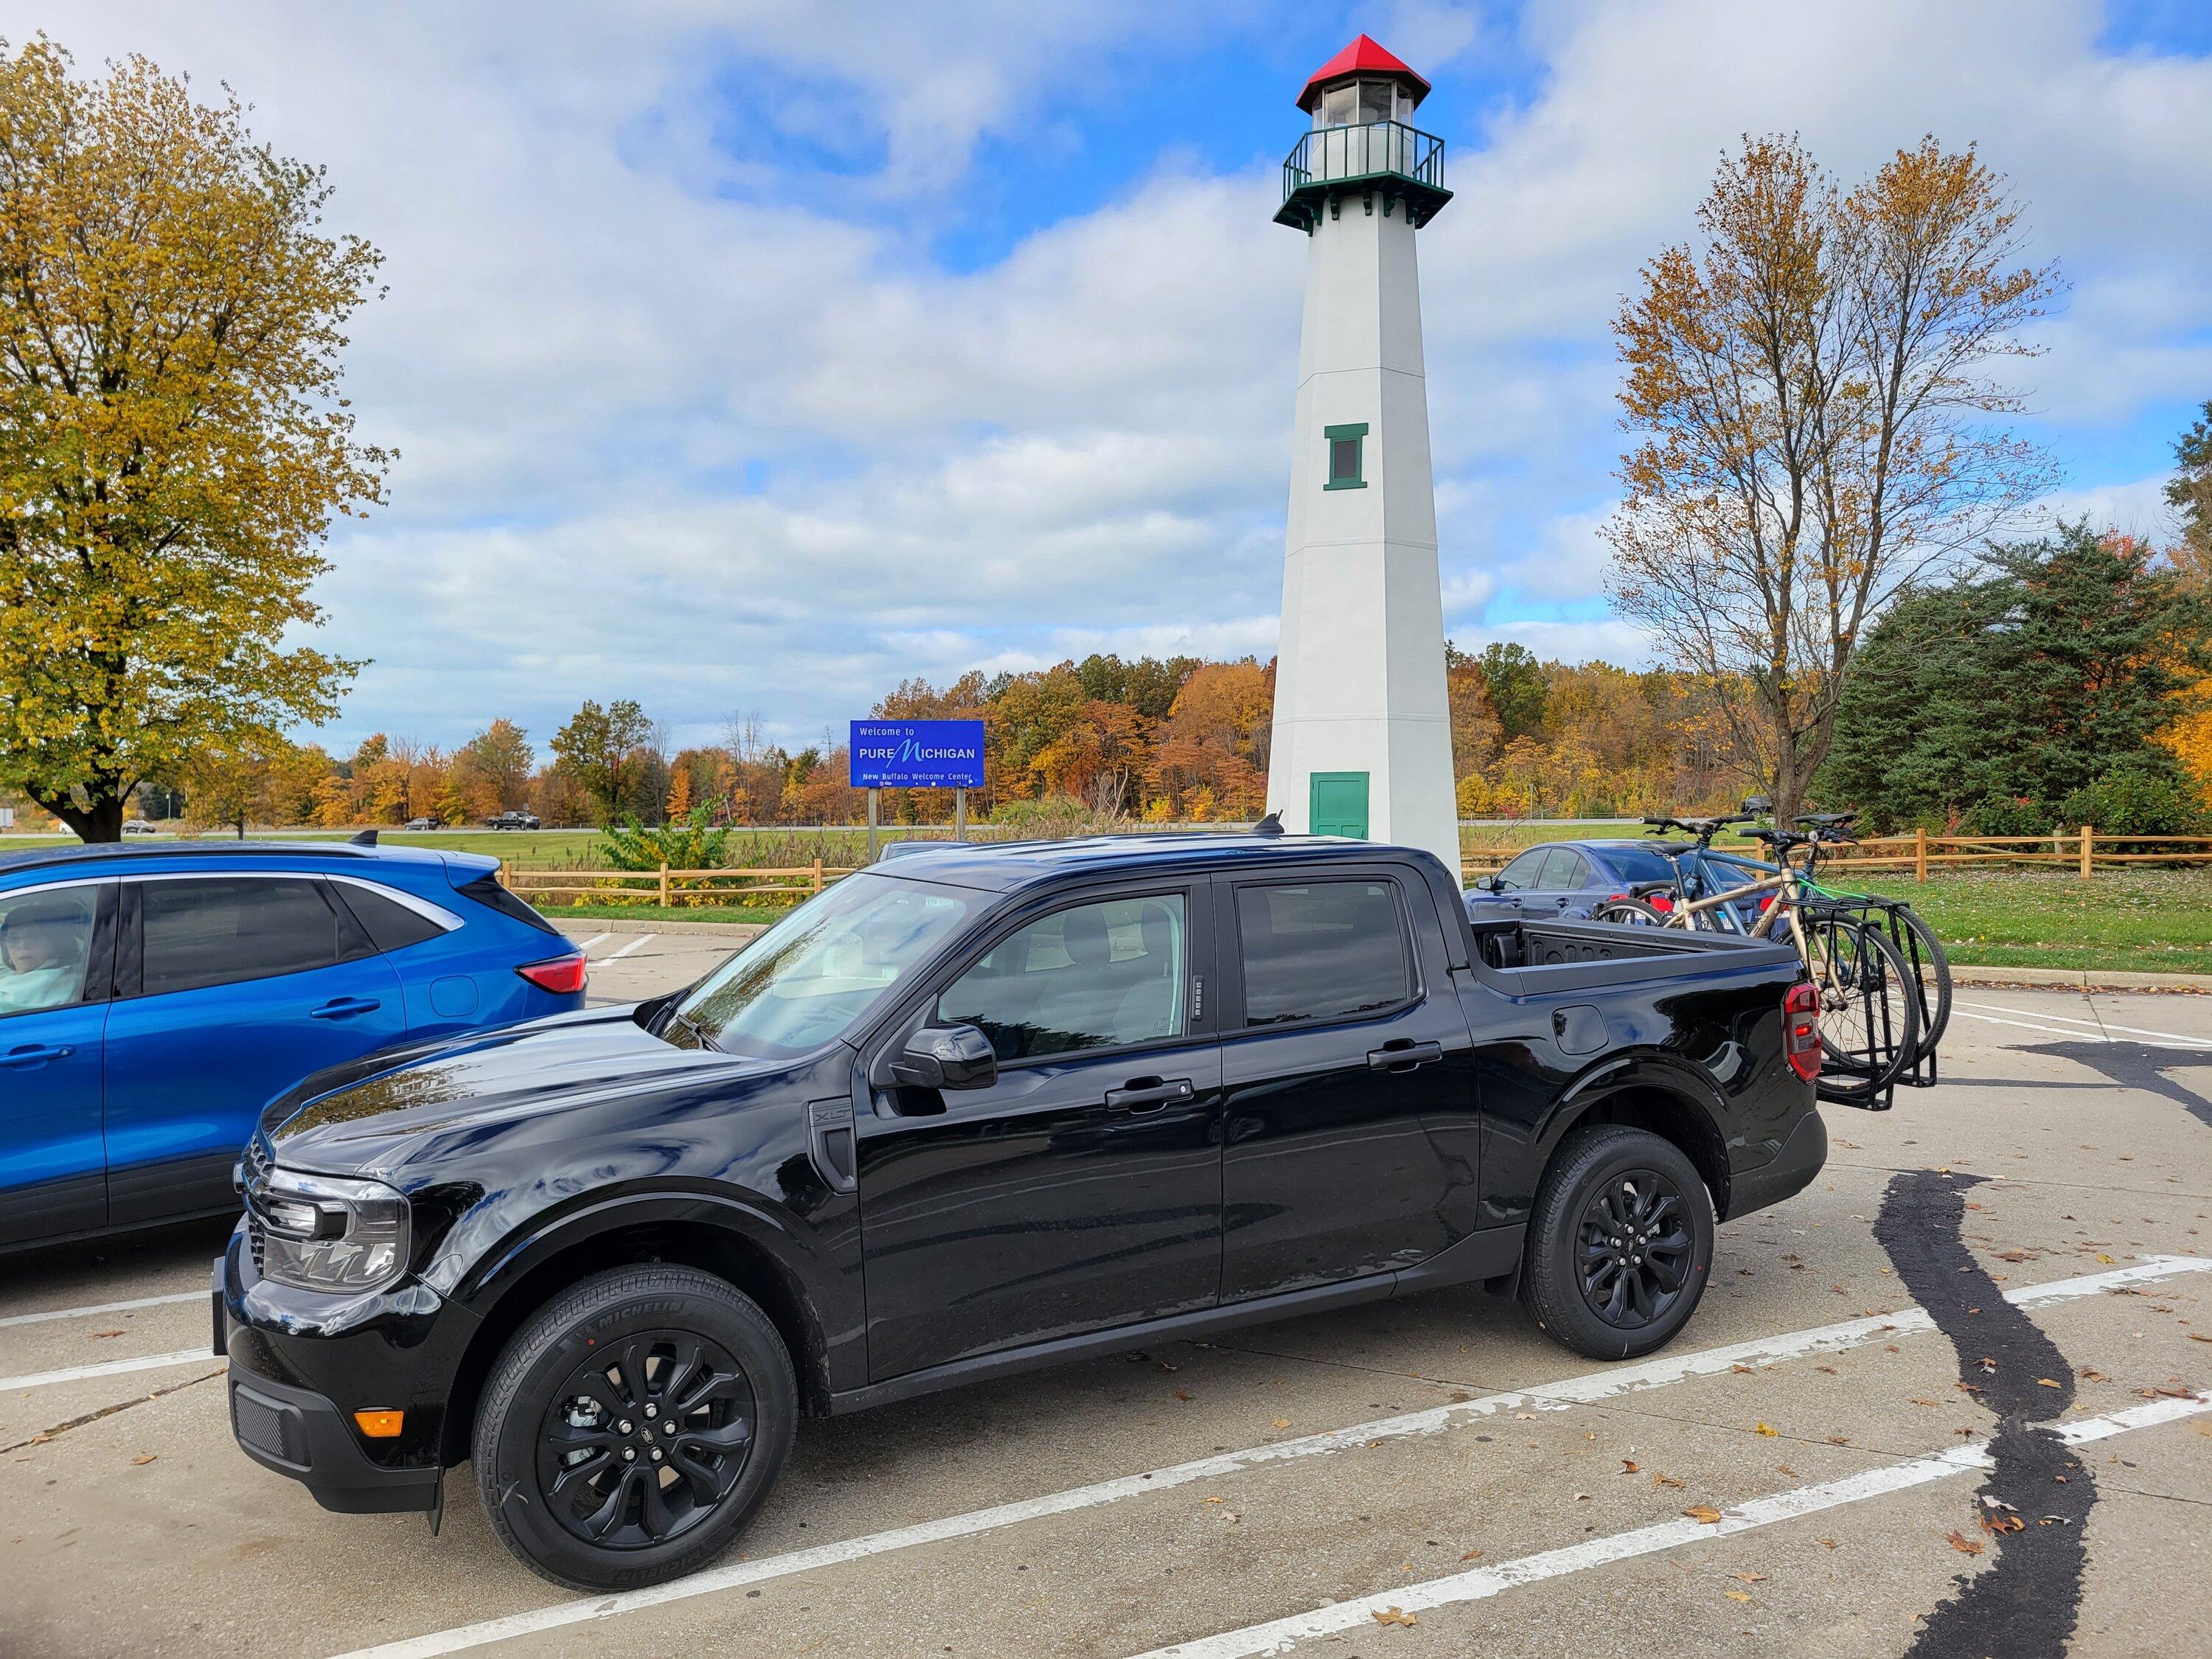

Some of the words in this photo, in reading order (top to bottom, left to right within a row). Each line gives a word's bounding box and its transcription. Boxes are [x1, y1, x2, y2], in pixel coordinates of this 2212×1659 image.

[860, 727, 901, 736] Welcome
[905, 727, 914, 736] to
[859, 748, 894, 759] PURE
[886, 738, 975, 768] MICHIGAN
[815, 1109, 851, 1121] XLT
[599, 1301, 684, 1328] MICHELIN
